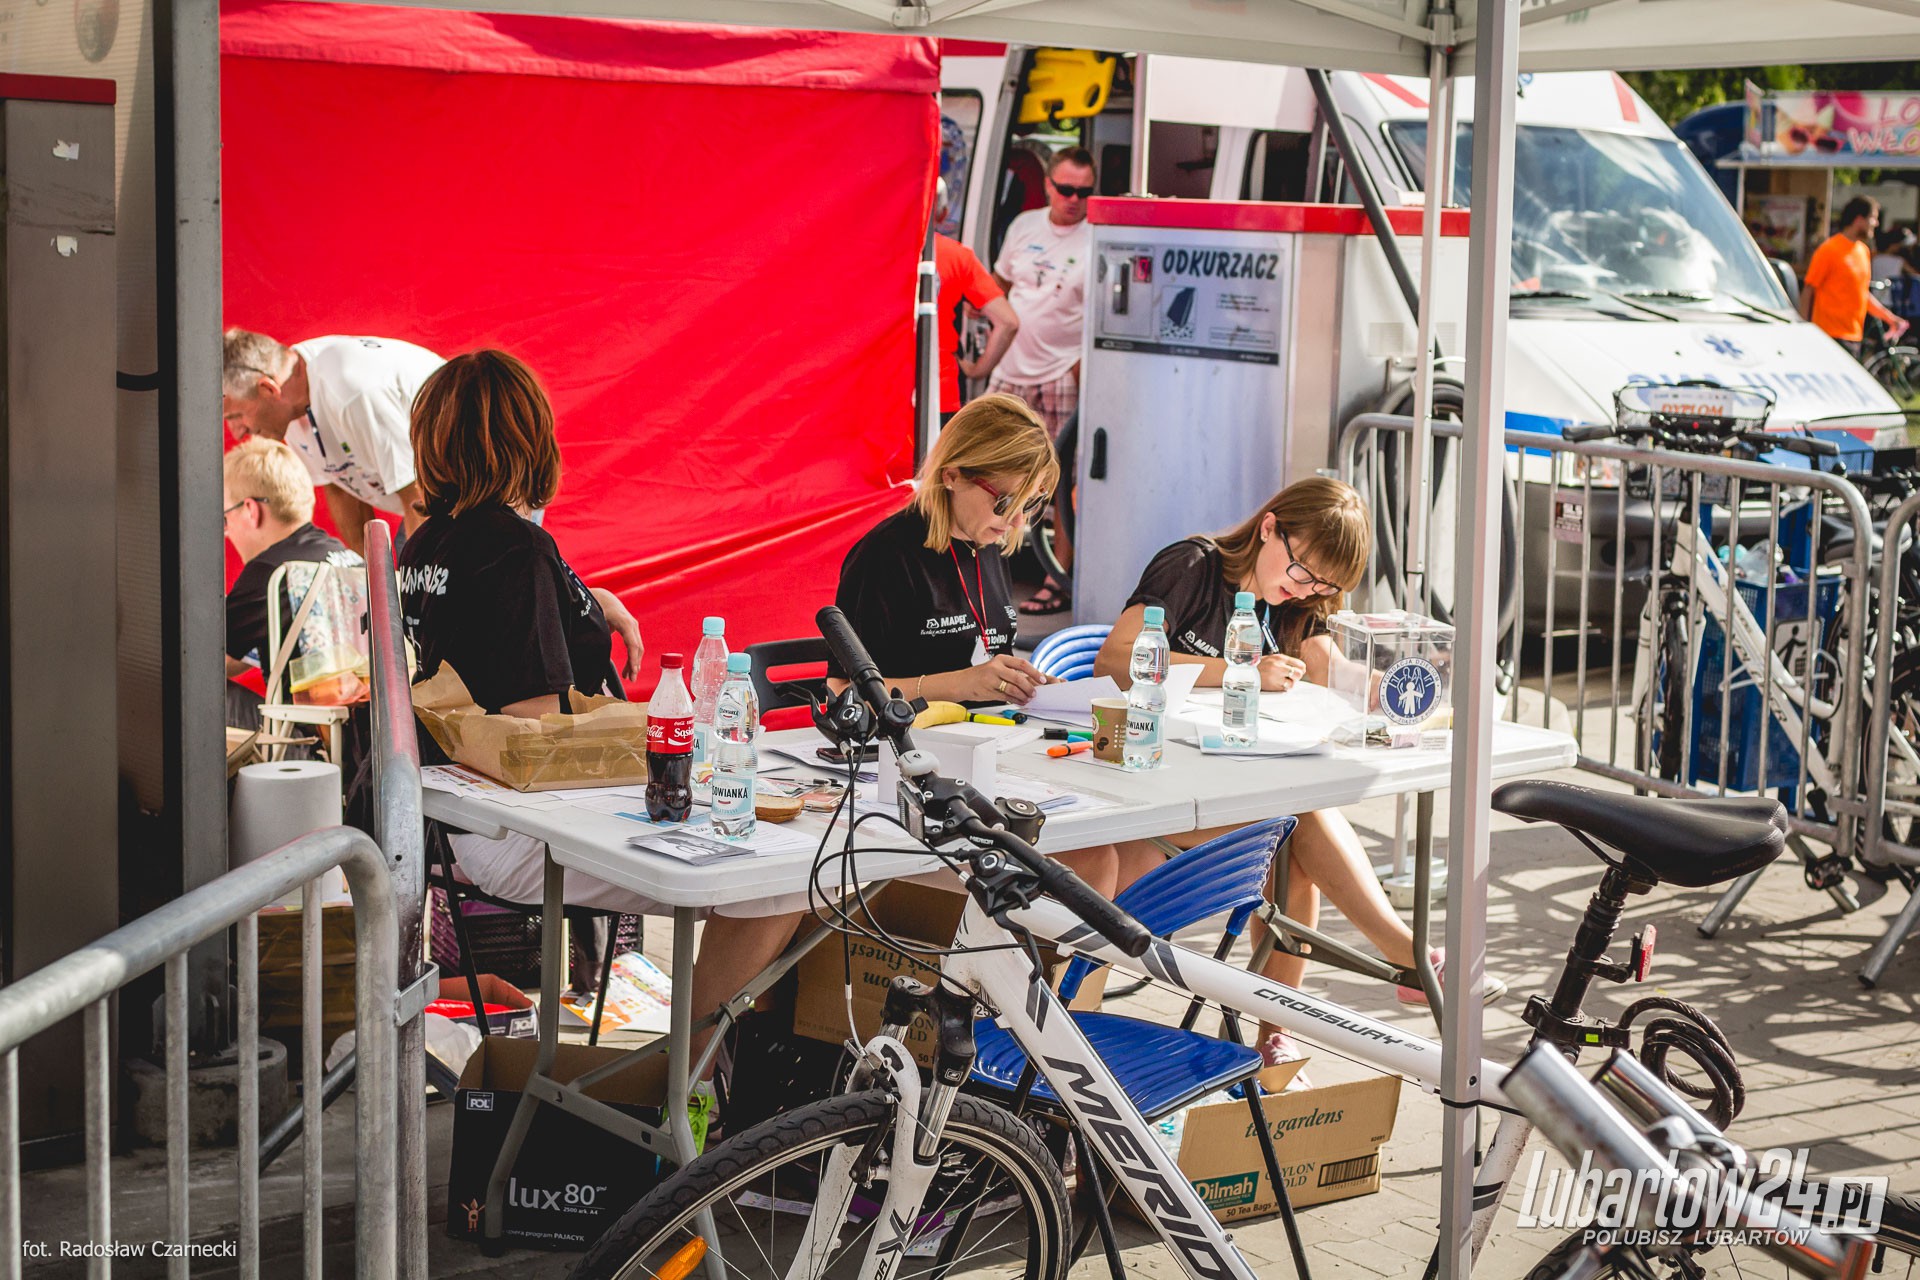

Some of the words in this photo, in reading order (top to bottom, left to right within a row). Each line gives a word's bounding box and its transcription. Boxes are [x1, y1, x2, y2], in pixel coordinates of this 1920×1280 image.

[1162, 249, 1279, 280] ODKURZACZ
[1383, 659, 1413, 684] FUNDACJA
[1415, 659, 1440, 682] DZIECIOM
[850, 942, 903, 971] finest
[1252, 988, 1404, 1045] CROSSWAY
[470, 1098, 490, 1109] POL
[1273, 1108, 1344, 1140] gardens
[1265, 1162, 1316, 1181] CYLON
[509, 1177, 562, 1211] lux
[564, 1183, 596, 1206] 80
[1195, 1177, 1254, 1201] Dilmah
[1226, 1208, 1237, 1217] 50
[1239, 1204, 1251, 1214] Tea
[1253, 1202, 1272, 1212] Bags
[525, 1231, 553, 1240] program
[553, 1232, 585, 1242] PAJACYK
